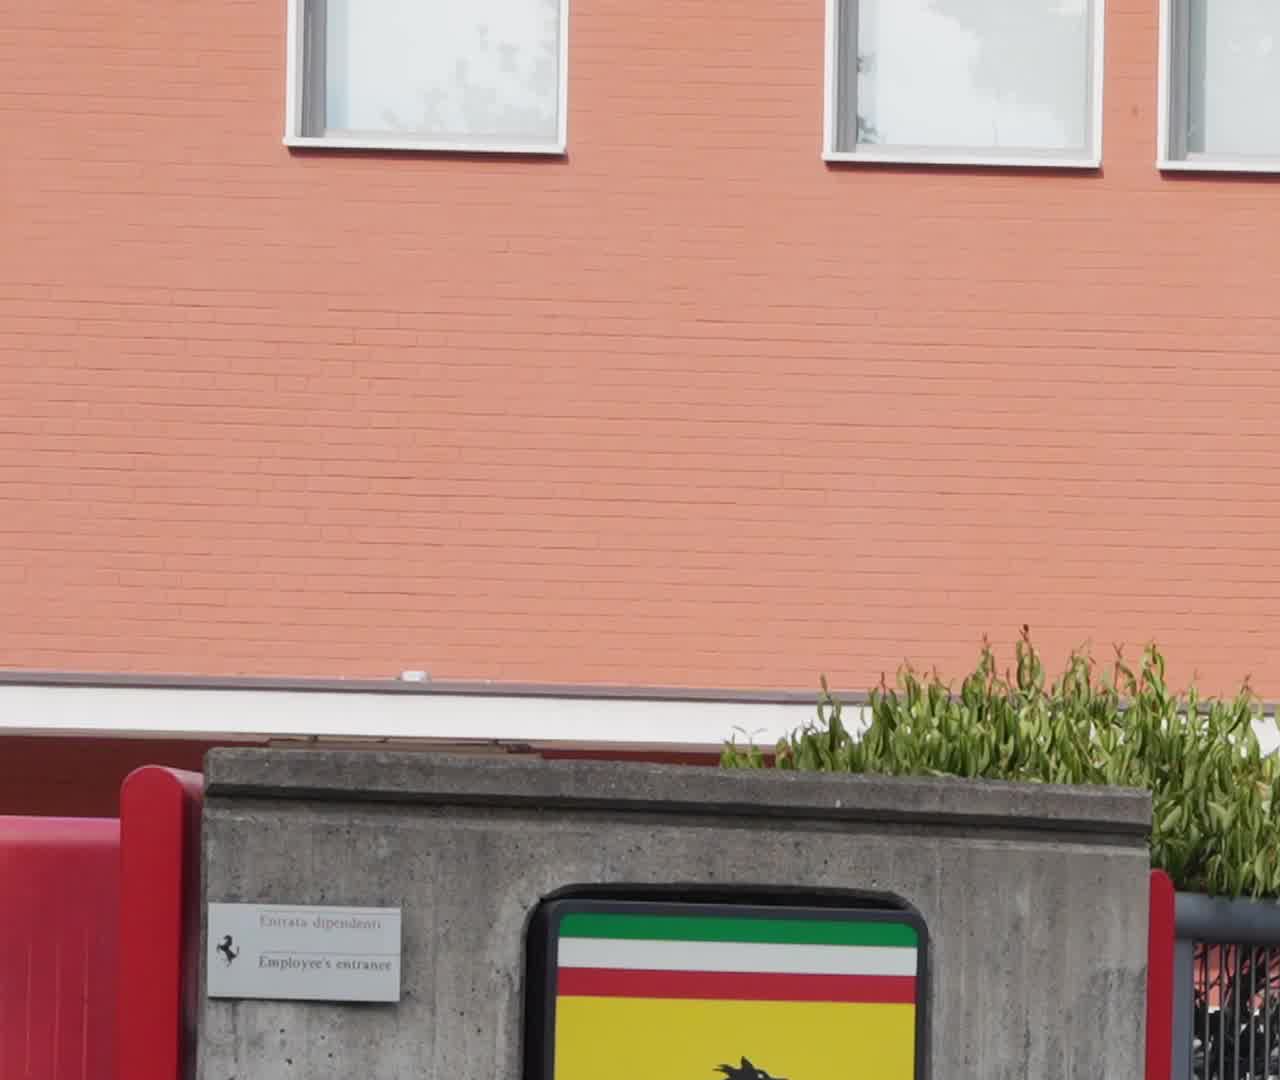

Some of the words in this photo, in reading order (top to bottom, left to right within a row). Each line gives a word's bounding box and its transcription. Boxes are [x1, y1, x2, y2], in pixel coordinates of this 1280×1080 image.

[259, 914, 308, 929] Entrata
[312, 916, 382, 932] dipendenti
[257, 955, 332, 973] Employee's
[335, 959, 393, 972] entrance
